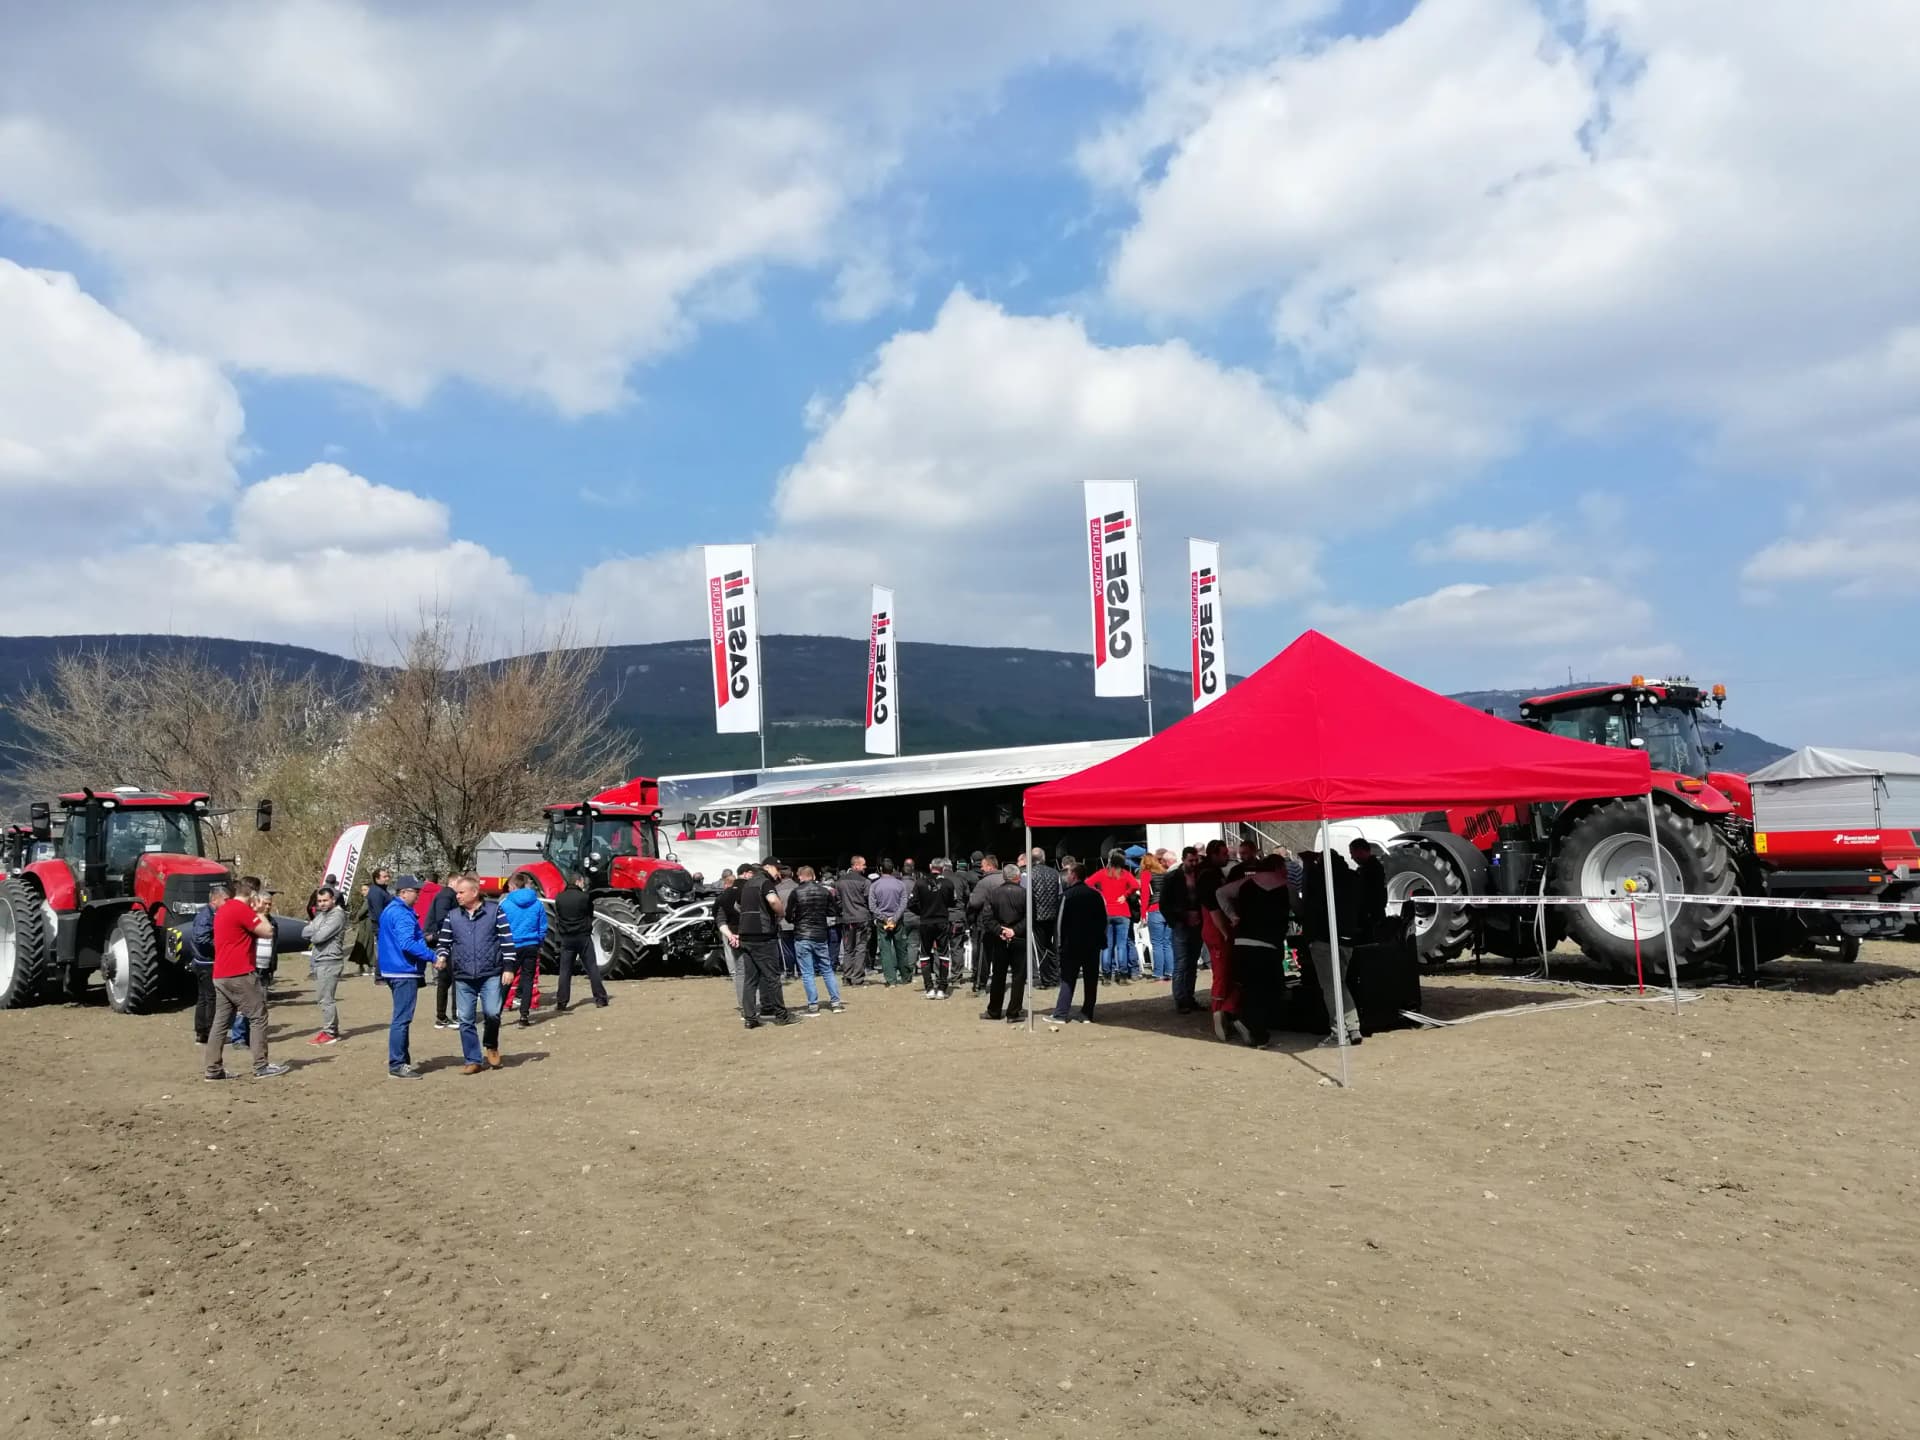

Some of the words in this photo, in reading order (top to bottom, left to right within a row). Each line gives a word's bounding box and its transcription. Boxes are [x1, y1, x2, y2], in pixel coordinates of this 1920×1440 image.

[684, 810, 742, 829] ASE
[715, 829, 759, 838] AGRICULTURE
[342, 845, 359, 897] HINERY
